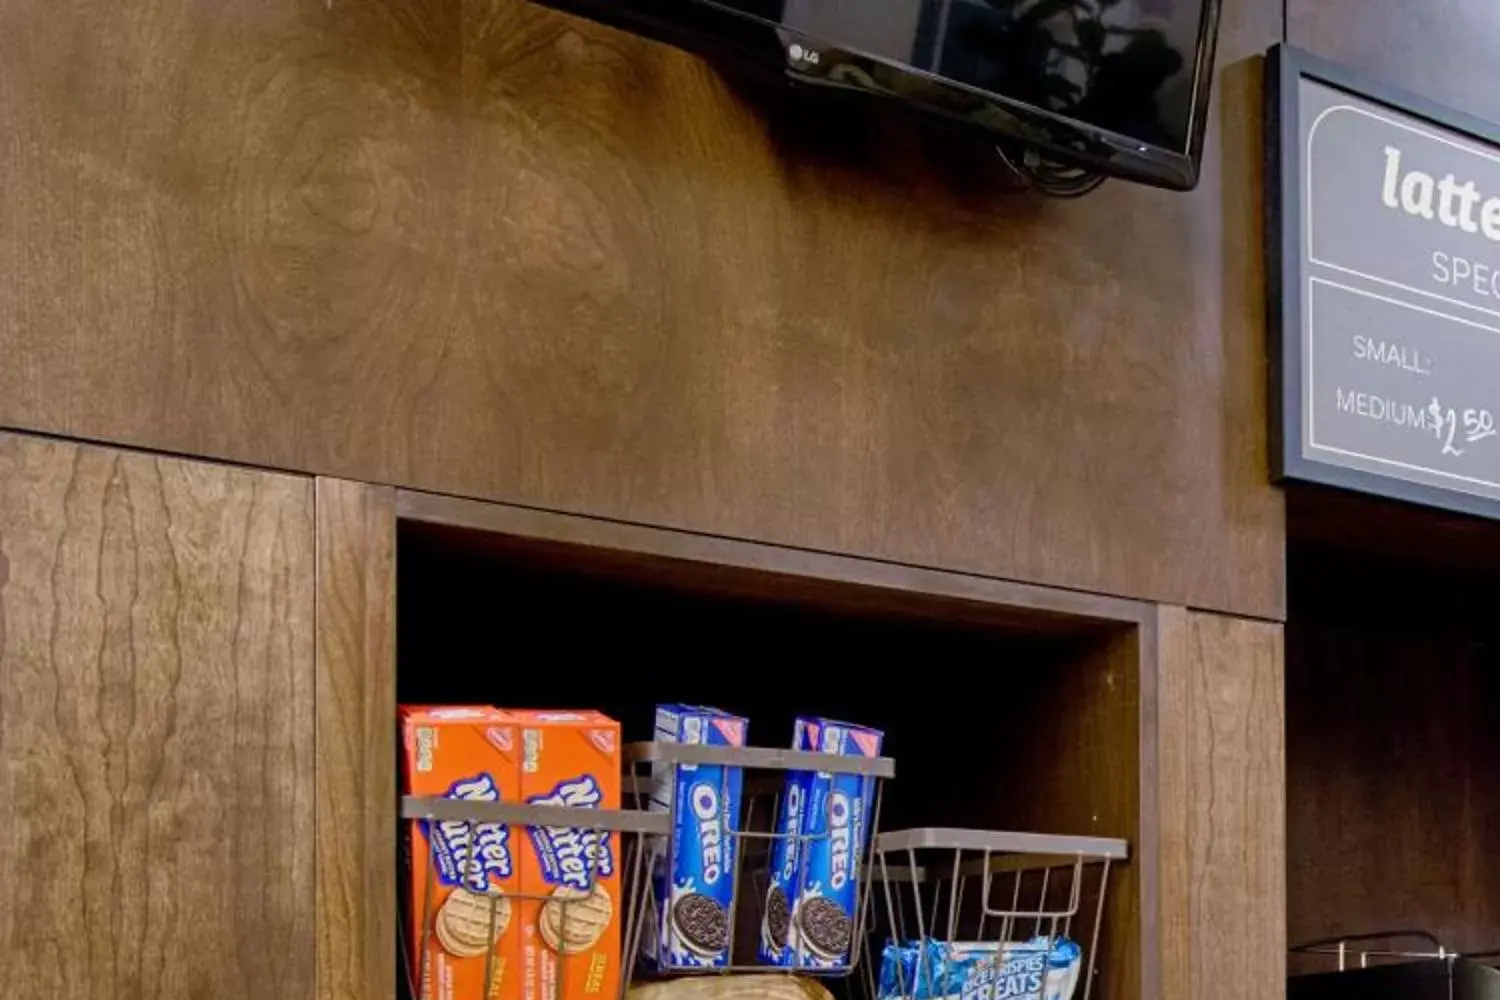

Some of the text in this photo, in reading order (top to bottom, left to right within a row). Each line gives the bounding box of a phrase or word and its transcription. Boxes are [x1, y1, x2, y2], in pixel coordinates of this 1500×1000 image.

[803, 50, 819, 65] LG
[1352, 335, 1431, 376] SMALL:
[454, 776, 510, 877] Ntter
[692, 784, 721, 886] OREO
[783, 783, 800, 882] OREO
[829, 791, 850, 890] OREO
